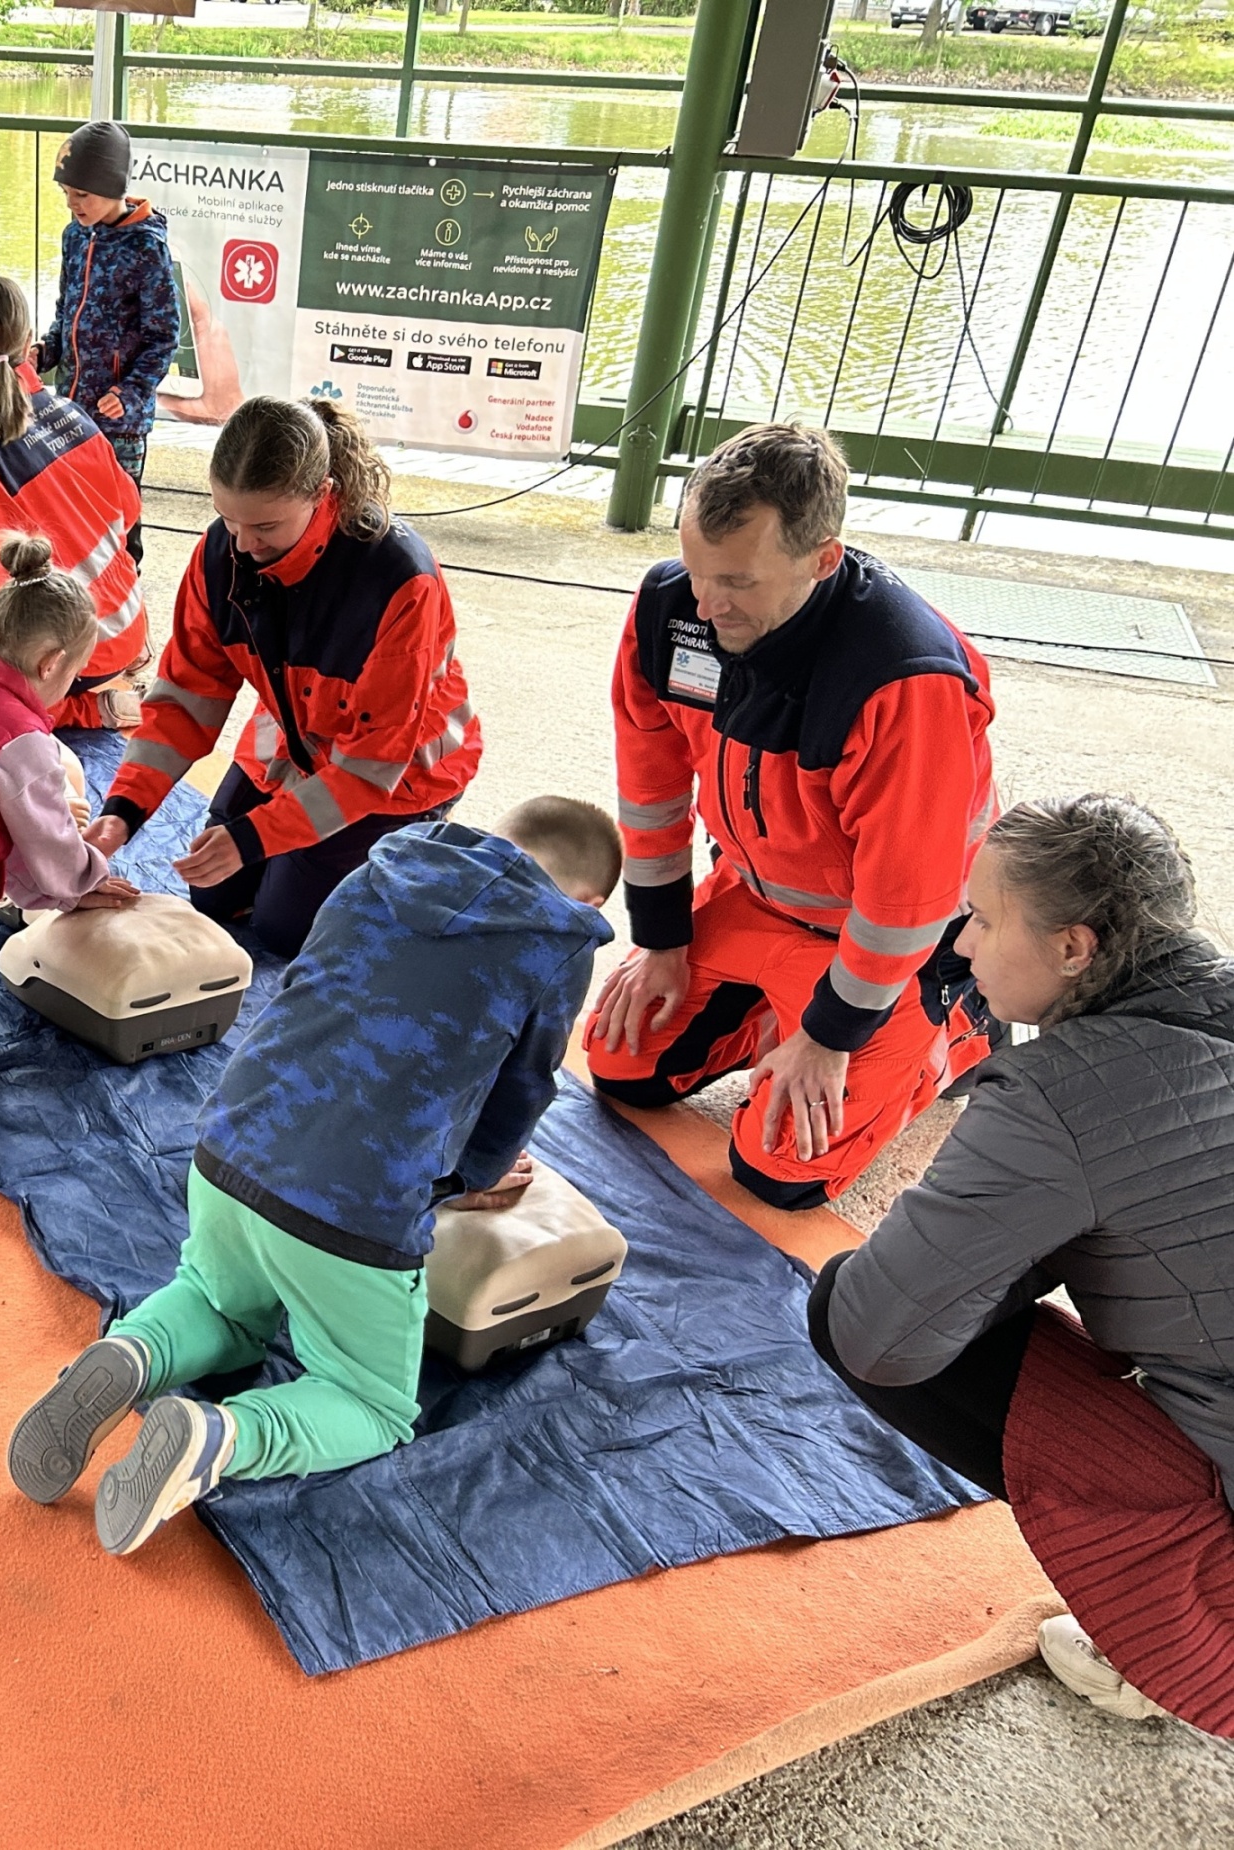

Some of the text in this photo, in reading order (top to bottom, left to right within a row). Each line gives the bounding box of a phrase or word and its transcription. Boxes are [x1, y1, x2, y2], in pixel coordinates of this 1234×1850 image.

[326, 180, 435, 196] Jedno stisknutí tlačítka
[502, 185, 592, 200] Rychlejší záchrana
[198, 195, 284, 213] Mobilní aplikace
[508, 198, 553, 211] okamžitá
[554, 203, 590, 213] pomoc
[156, 206, 283, 228] tnické záchranné služby
[336, 242, 381, 253] Ihned víme
[323, 251, 338, 260] kde
[340, 253, 349, 261] se
[420, 248, 446, 258] Máme
[455, 251, 468, 260] vás
[415, 257, 472, 271] více informací
[504, 255, 569, 268] Přístupnost pro
[493, 265, 534, 274] nevidomé
[543, 267, 579, 278] neslyšící
[336, 281, 553, 311] www.zachrankaApp.cz
[314, 320, 566, 354] Stáhněte si do svého telefonu
[347, 353, 388, 365] Google Play
[426, 361, 466, 372] App Store
[504, 368, 537, 377] Microsoft
[357, 382, 396, 394] Doporučuje
[356, 391, 400, 402] Zdravotnická
[488, 395, 556, 407] Generální partner
[525, 413, 554, 422] Nadace
[516, 423, 552, 432] Vodafone
[490, 429, 550, 442] Česká republika
